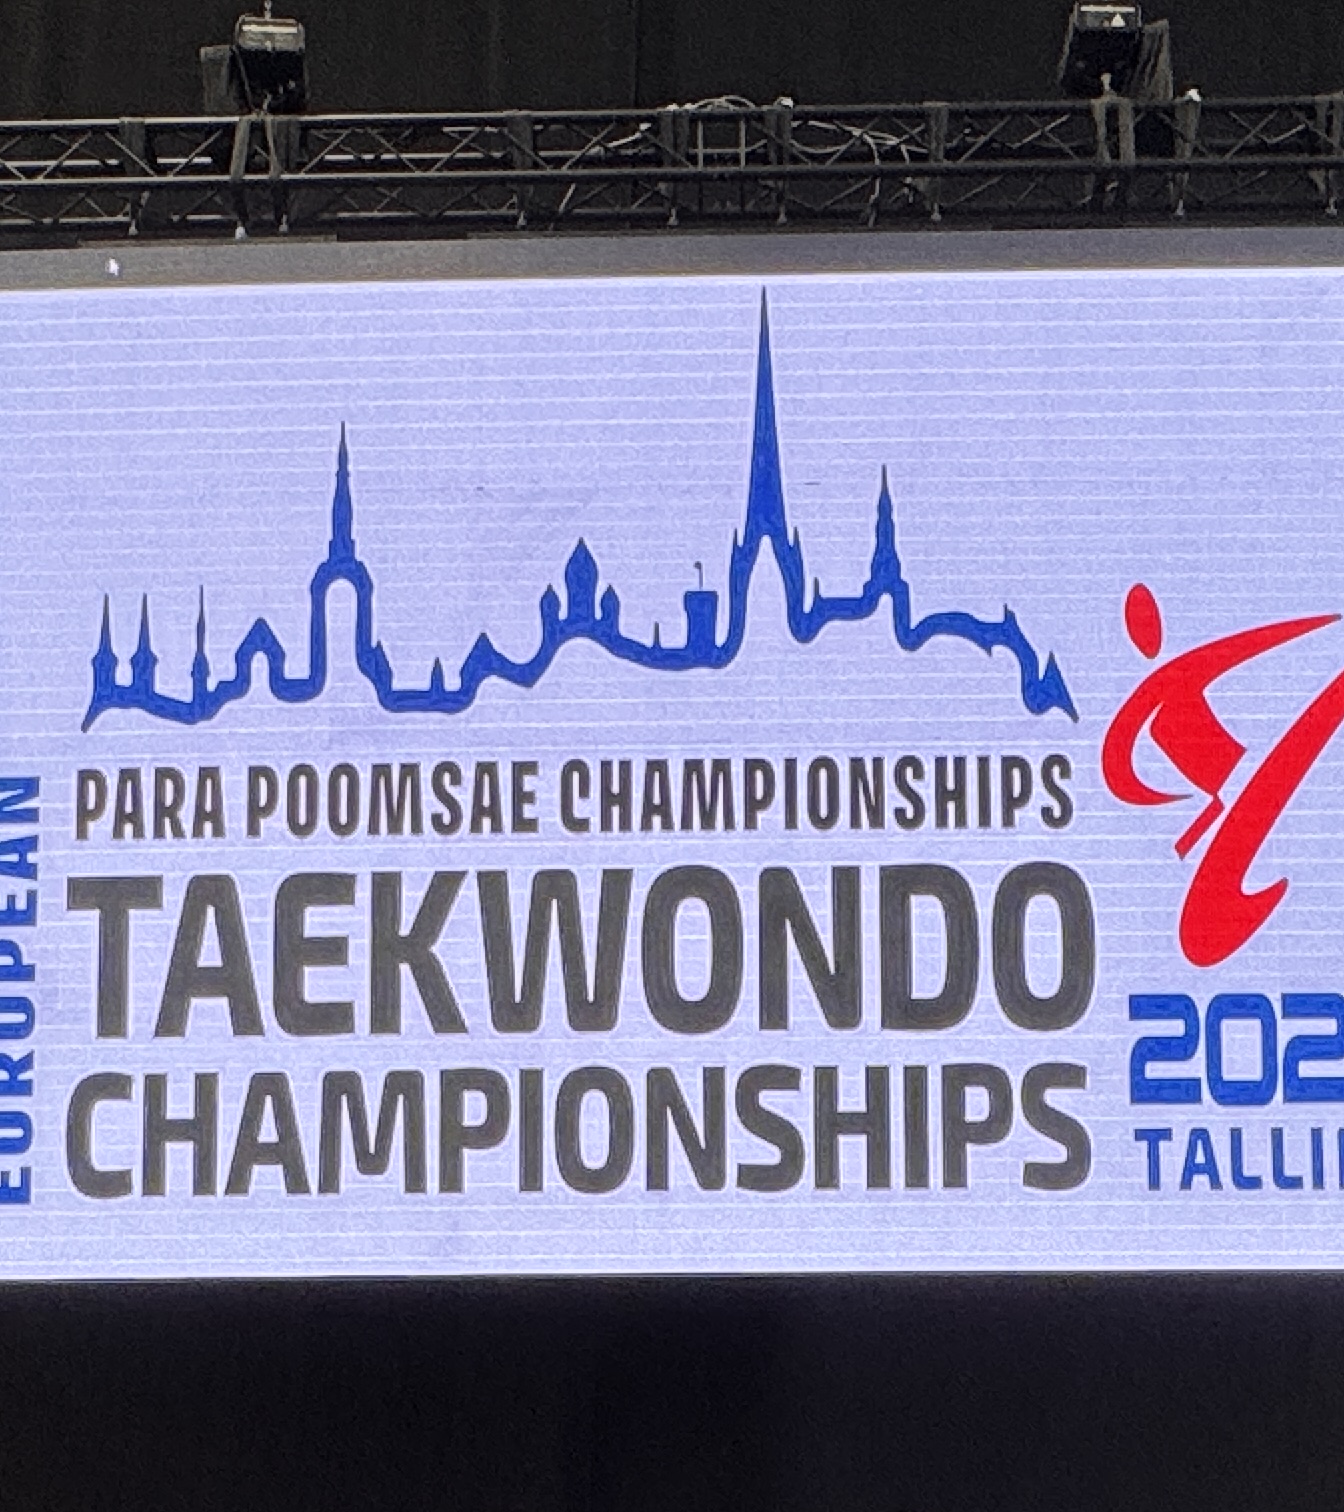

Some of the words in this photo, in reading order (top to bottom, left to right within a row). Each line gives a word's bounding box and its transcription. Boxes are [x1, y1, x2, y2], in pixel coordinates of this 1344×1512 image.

[76, 766, 224, 840] PARA
[247, 760, 538, 836] POOMSAE
[560, 754, 1074, 832] CHAMPIONSHIPS
[66, 861, 1095, 1038] TAEKWONDO
[66, 1062, 1092, 1198] CHAMPIONSHIPS
